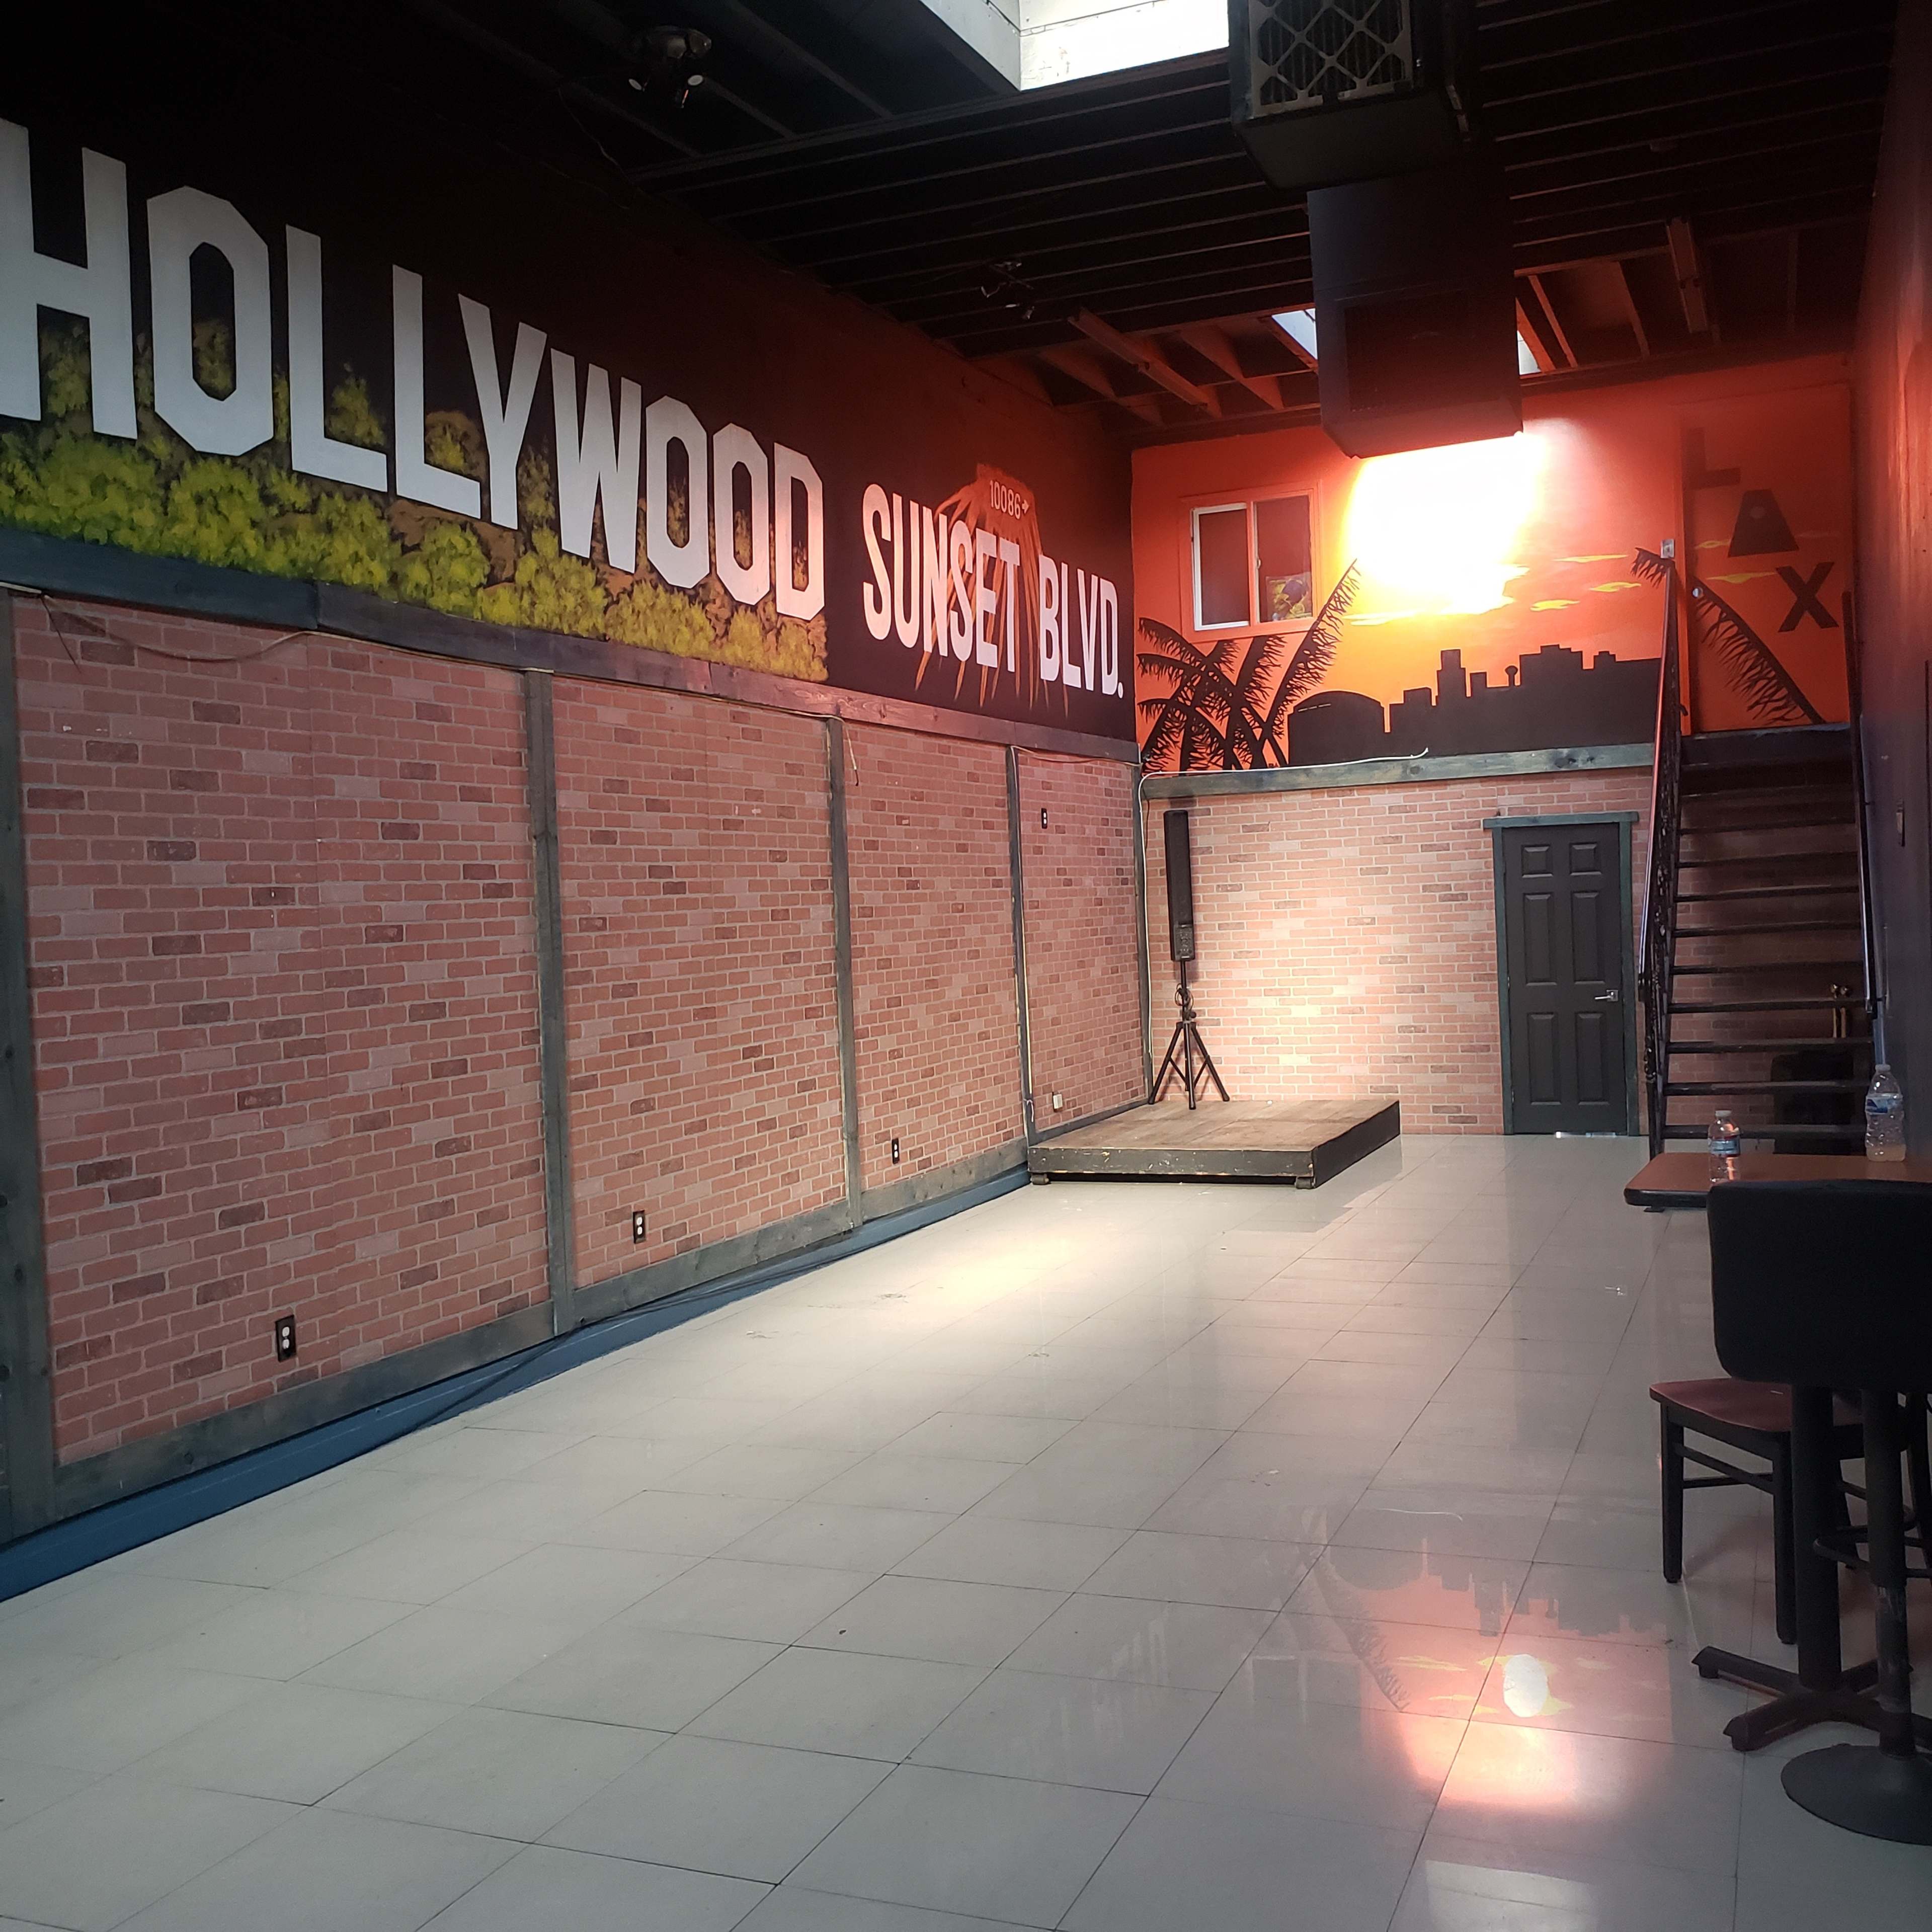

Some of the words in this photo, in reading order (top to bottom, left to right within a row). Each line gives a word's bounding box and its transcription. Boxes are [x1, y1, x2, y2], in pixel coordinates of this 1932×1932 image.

[0, 118, 825, 620] HOLLYWOOD
[863, 484, 1020, 672] SUNSET
[1039, 554, 1123, 699] BLVD.
[990, 480, 1021, 519] 10086
